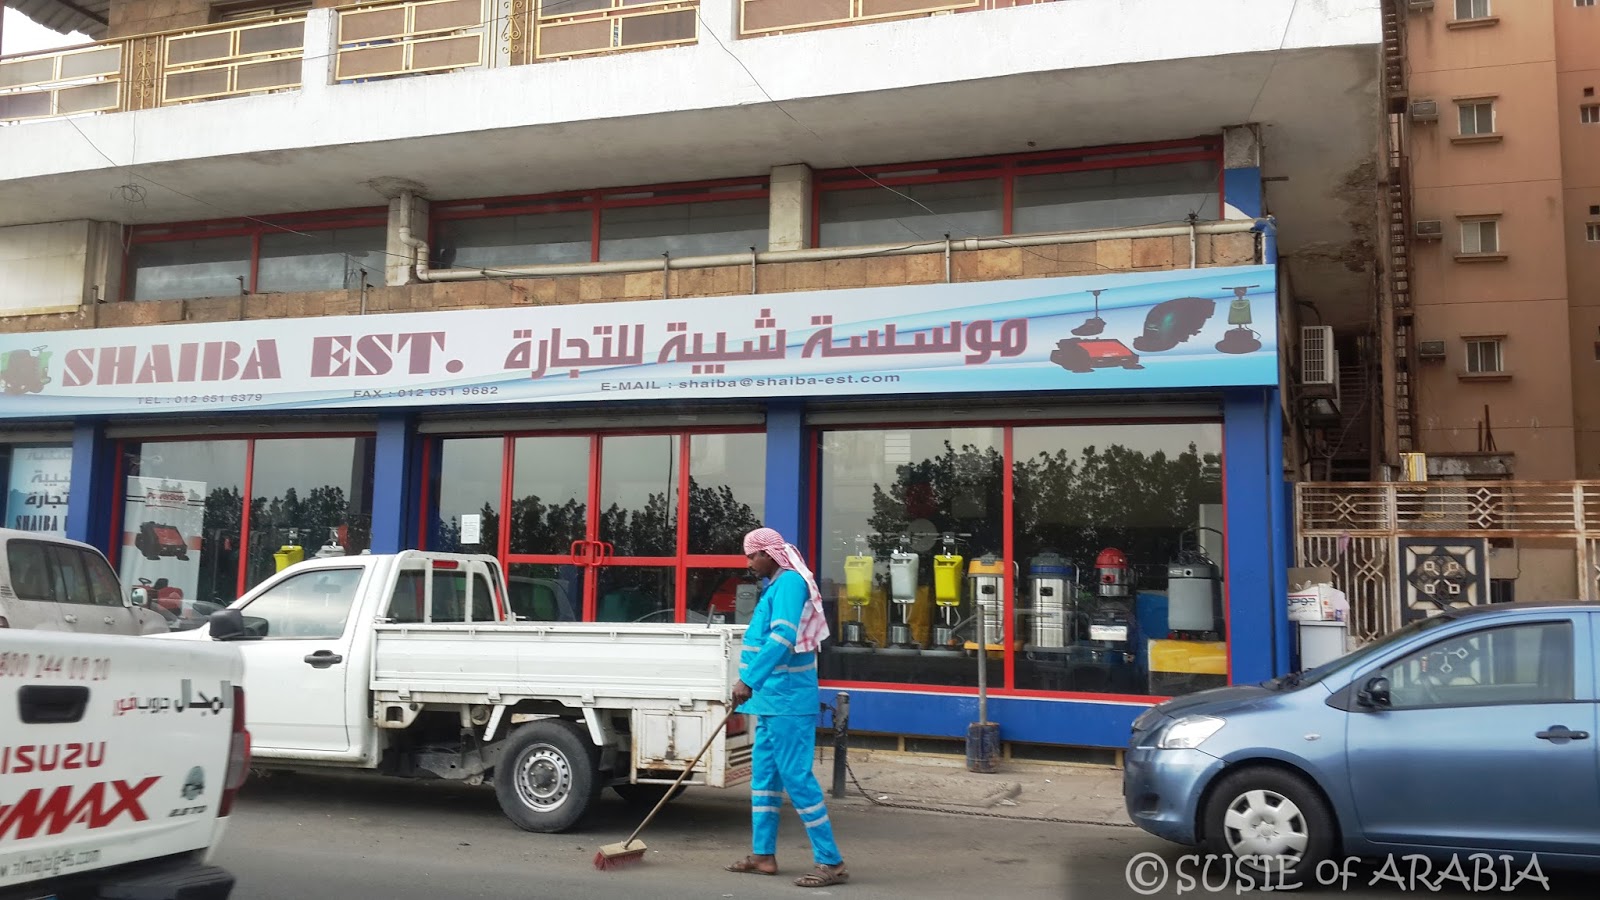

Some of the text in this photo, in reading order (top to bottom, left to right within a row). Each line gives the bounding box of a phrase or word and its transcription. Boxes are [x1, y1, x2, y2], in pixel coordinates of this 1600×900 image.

[502, 322, 645, 380] للتجارة
[657, 307, 786, 375] شيبة
[62, 331, 464, 387] SHAIBA EST.
[353, 389, 382, 398] FAX
[399, 388, 424, 398] 012
[429, 388, 455, 397] 651
[461, 386, 499, 396] 9682
[600, 380, 662, 392] E-MAIL
[678, 372, 901, 389] shaiba@shaiba-est.com
[137, 396, 162, 405] TEL
[174, 394, 198, 404] 012
[202, 394, 225, 403] 651
[230, 392, 263, 402] 6379
[15, 514, 58, 532] SHAIBA
[1, 741, 107, 775] ISUZU
